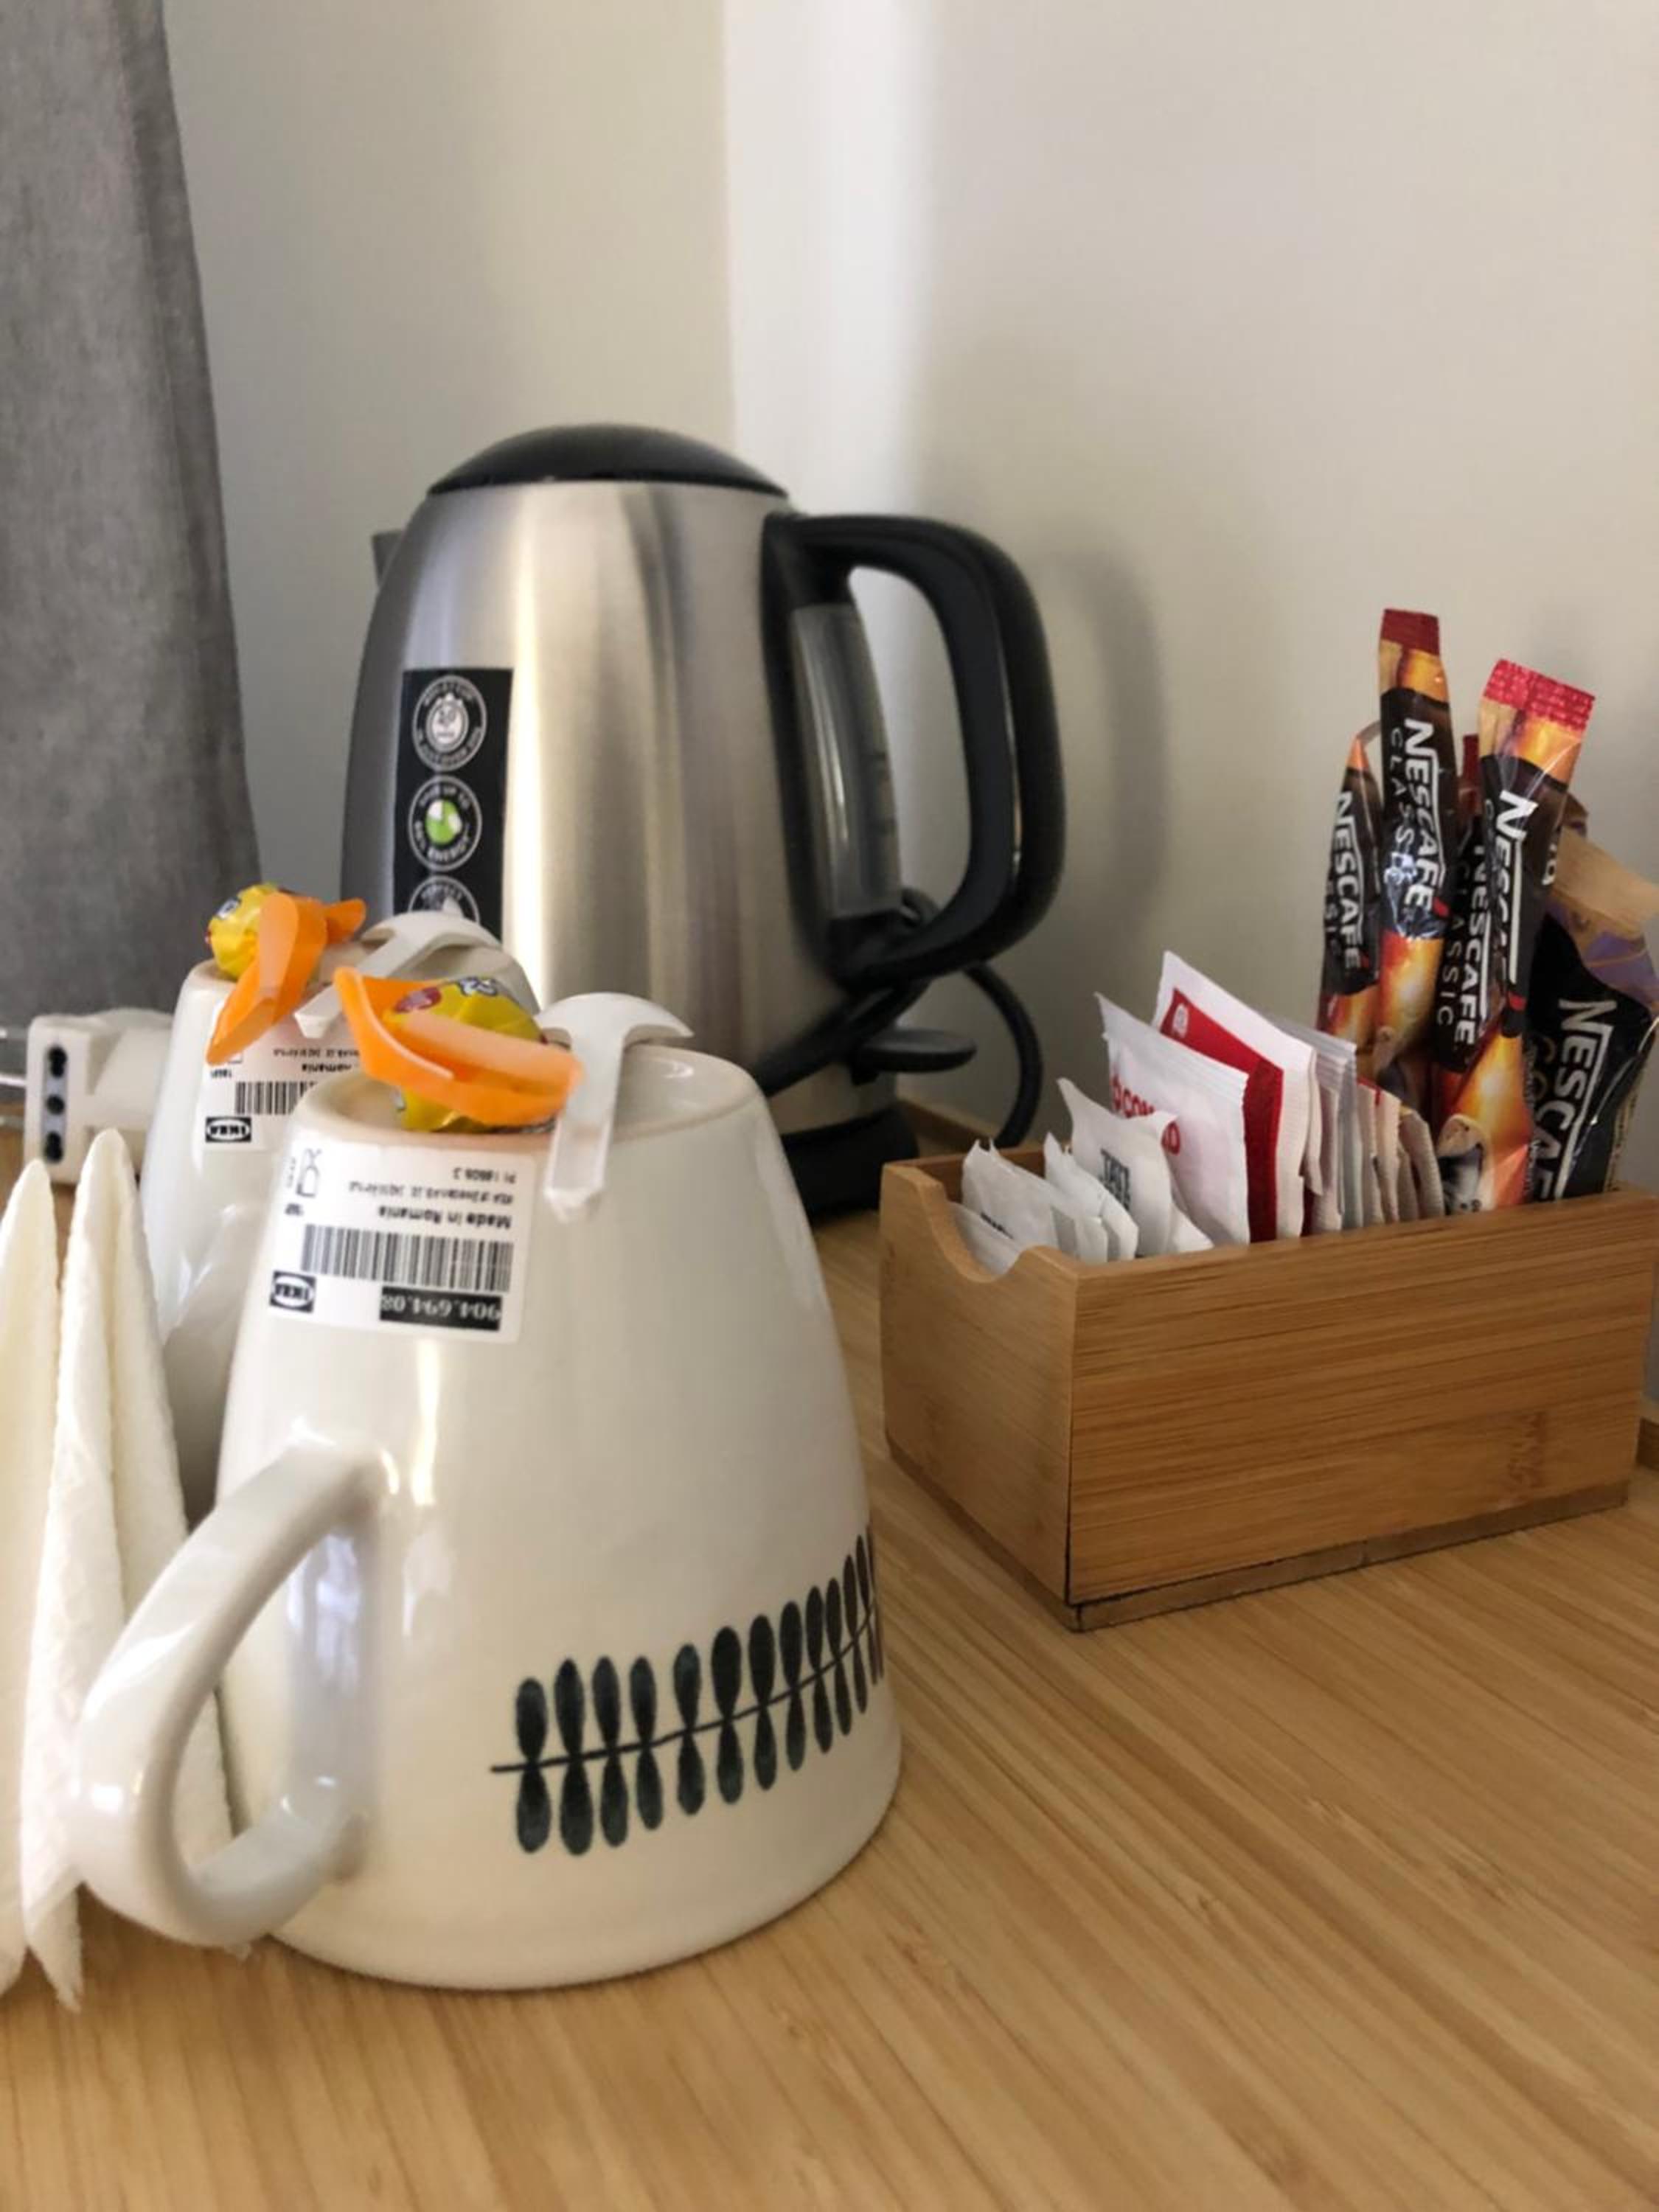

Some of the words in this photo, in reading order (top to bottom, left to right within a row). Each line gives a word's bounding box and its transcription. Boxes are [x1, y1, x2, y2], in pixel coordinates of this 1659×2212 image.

[1437, 860, 1470, 1026] CASSIC
[1534, 1000, 1617, 1199] NESCAF
[378, 1206, 442, 1224] Romania
[447, 1211, 464, 1224] in
[467, 1212, 512, 1229] Made
[379, 1293, 502, 1321] 904.694.08
